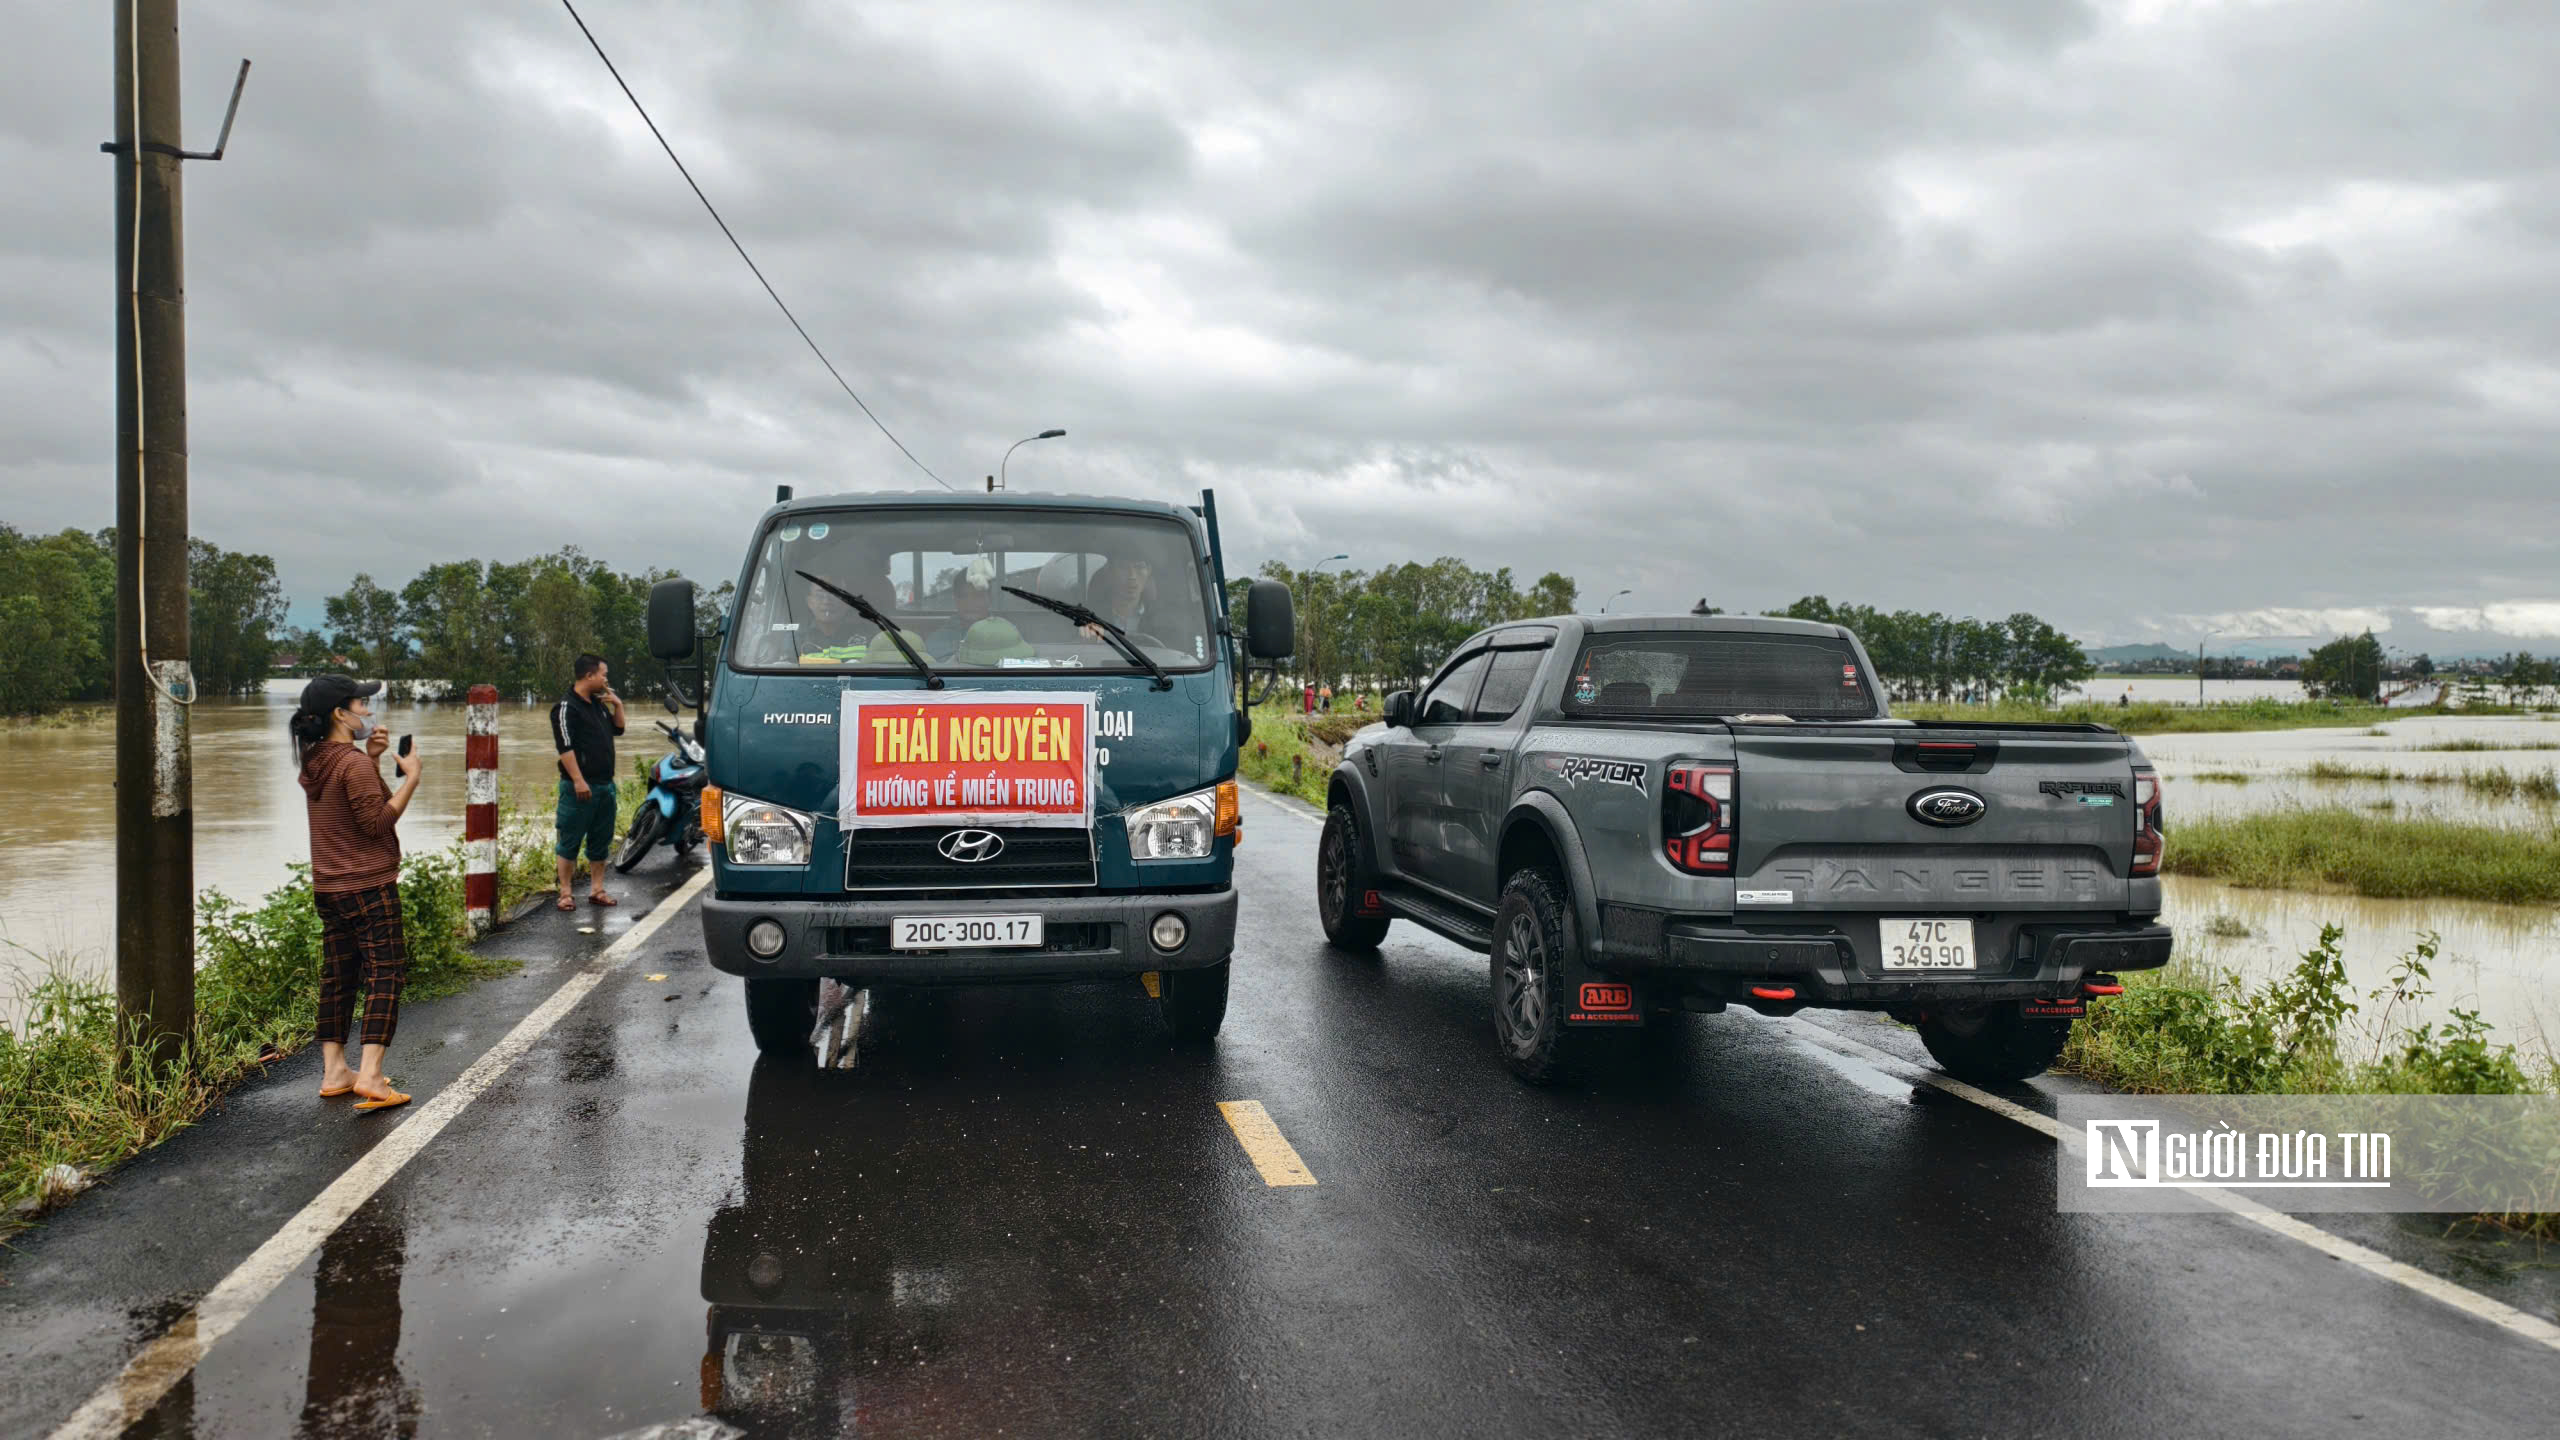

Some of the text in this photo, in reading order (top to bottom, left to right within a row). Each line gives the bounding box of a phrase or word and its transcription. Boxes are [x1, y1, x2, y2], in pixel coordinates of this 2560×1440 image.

[763, 713, 832, 724] HYUNDAI
[1094, 710, 1133, 741] LOẠI
[872, 707, 1071, 763] THÁI NGUYÊN
[865, 769, 1075, 808] HƯỚNG VỀ MIỀN TRUNG
[1558, 756, 1649, 799] RAPTOR
[2039, 781, 2126, 800] RAPTOR
[1933, 798, 1970, 815] Ford
[1775, 868, 2098, 893] RANGER
[905, 921, 1030, 942] 20C-300.17
[1908, 921, 1948, 943] 47C
[1892, 945, 1965, 967] 349.90
[1586, 988, 1627, 1005] ARB
